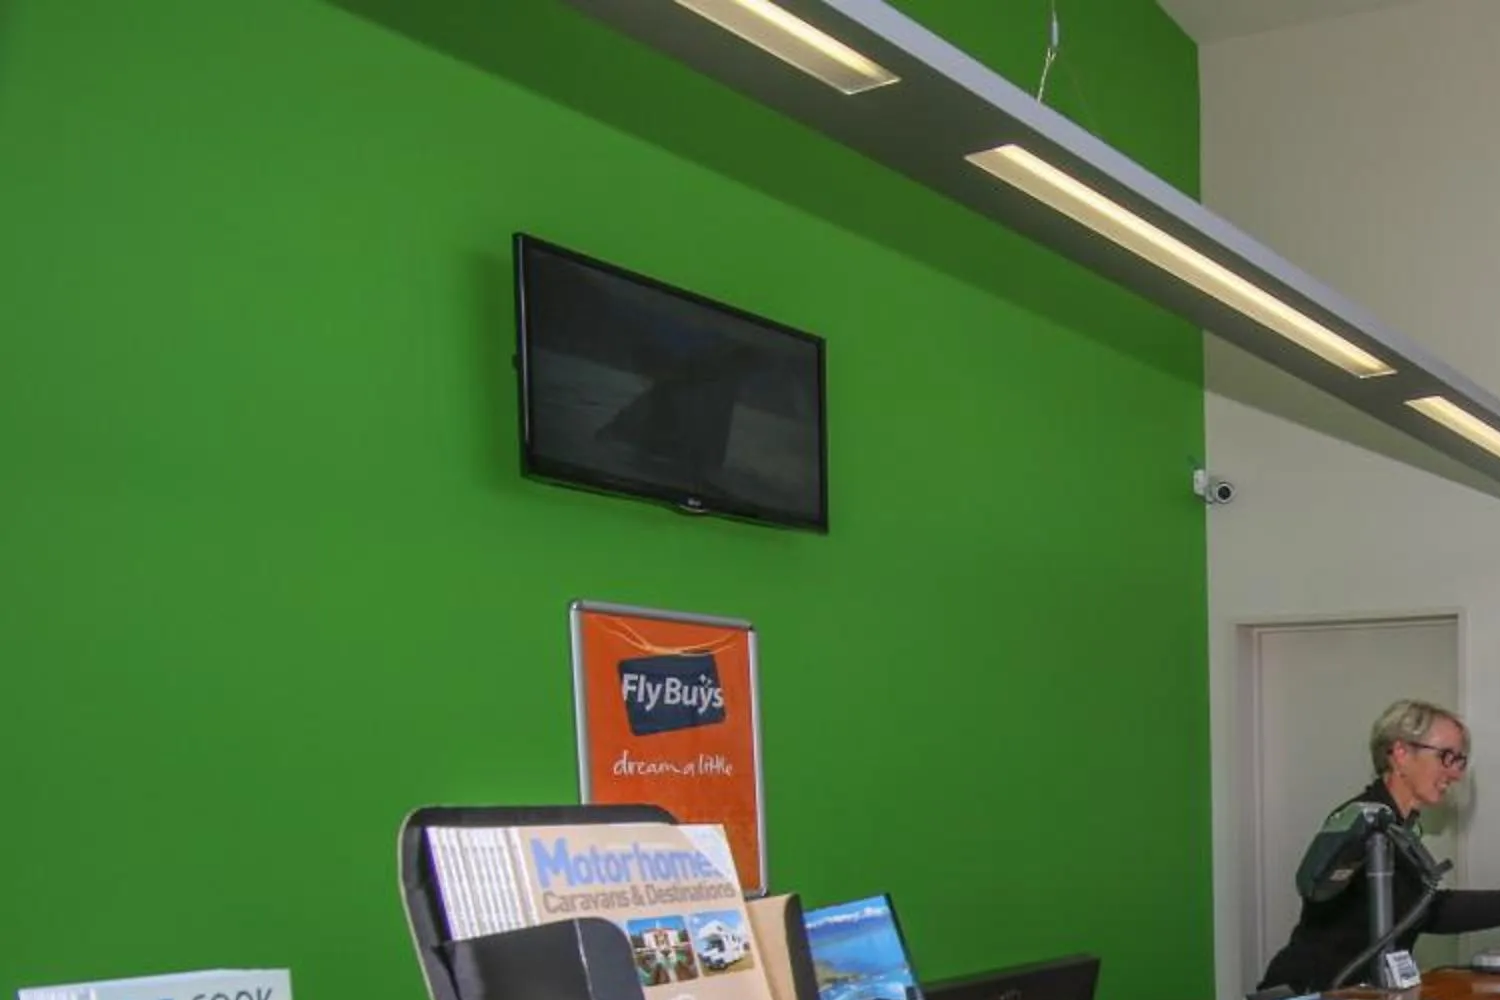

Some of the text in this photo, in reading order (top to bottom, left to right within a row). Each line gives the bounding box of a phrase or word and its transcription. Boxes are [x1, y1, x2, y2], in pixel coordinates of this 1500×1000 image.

[622, 673, 724, 714] FlyBuys
[613, 751, 679, 776] dream
[699, 753, 733, 777] little
[543, 881, 737, 914] Caravans & Destinations
